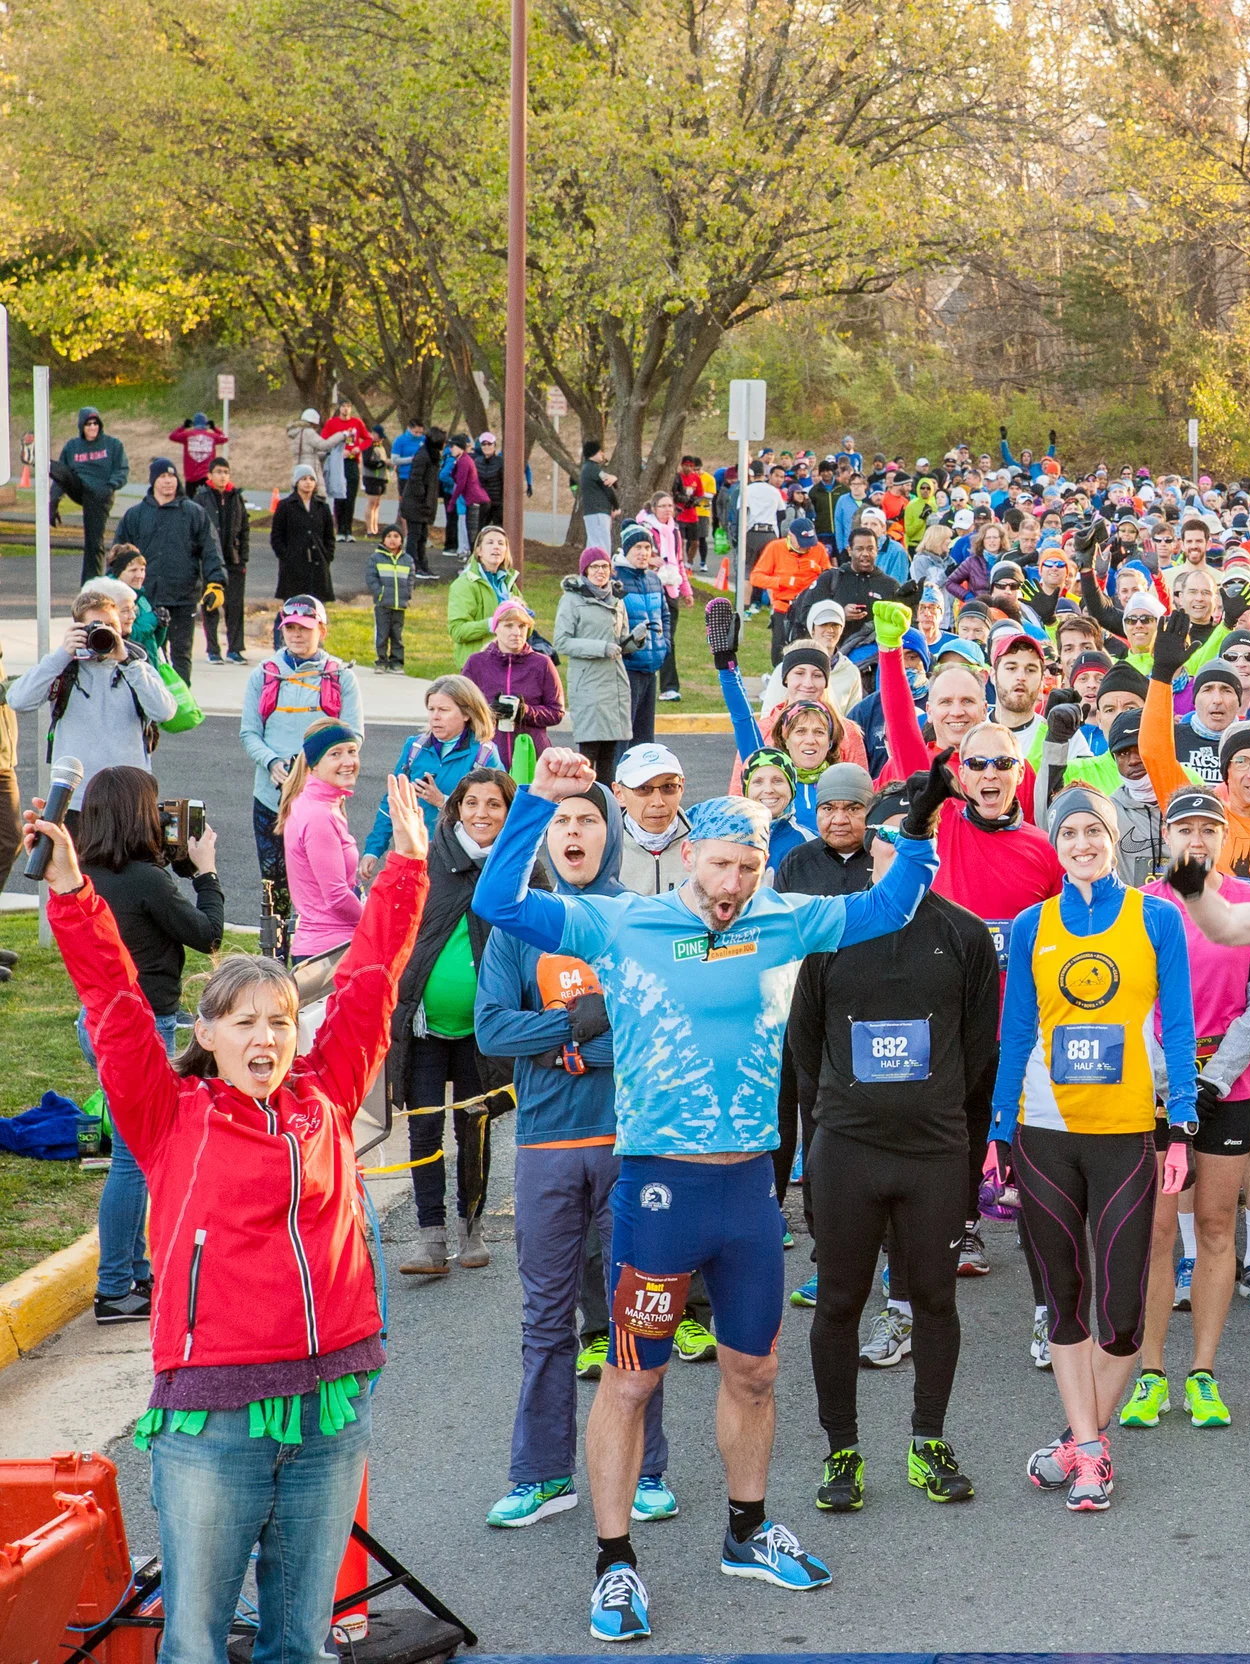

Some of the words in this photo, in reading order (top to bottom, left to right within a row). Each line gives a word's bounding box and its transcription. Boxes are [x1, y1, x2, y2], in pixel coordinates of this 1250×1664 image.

[1189, 750, 1219, 767] Res
[677, 939, 705, 958] PINE
[559, 968, 583, 990] 64
[560, 987, 586, 999] RELAY
[872, 1036, 908, 1058] 832
[1067, 1039, 1100, 1060] 831
[880, 1060, 901, 1068] HALF
[1074, 1062, 1095, 1070] HALF
[646, 1282, 665, 1292] Matt
[635, 1289, 672, 1314] 179
[624, 1306, 674, 1323] MARATHON
